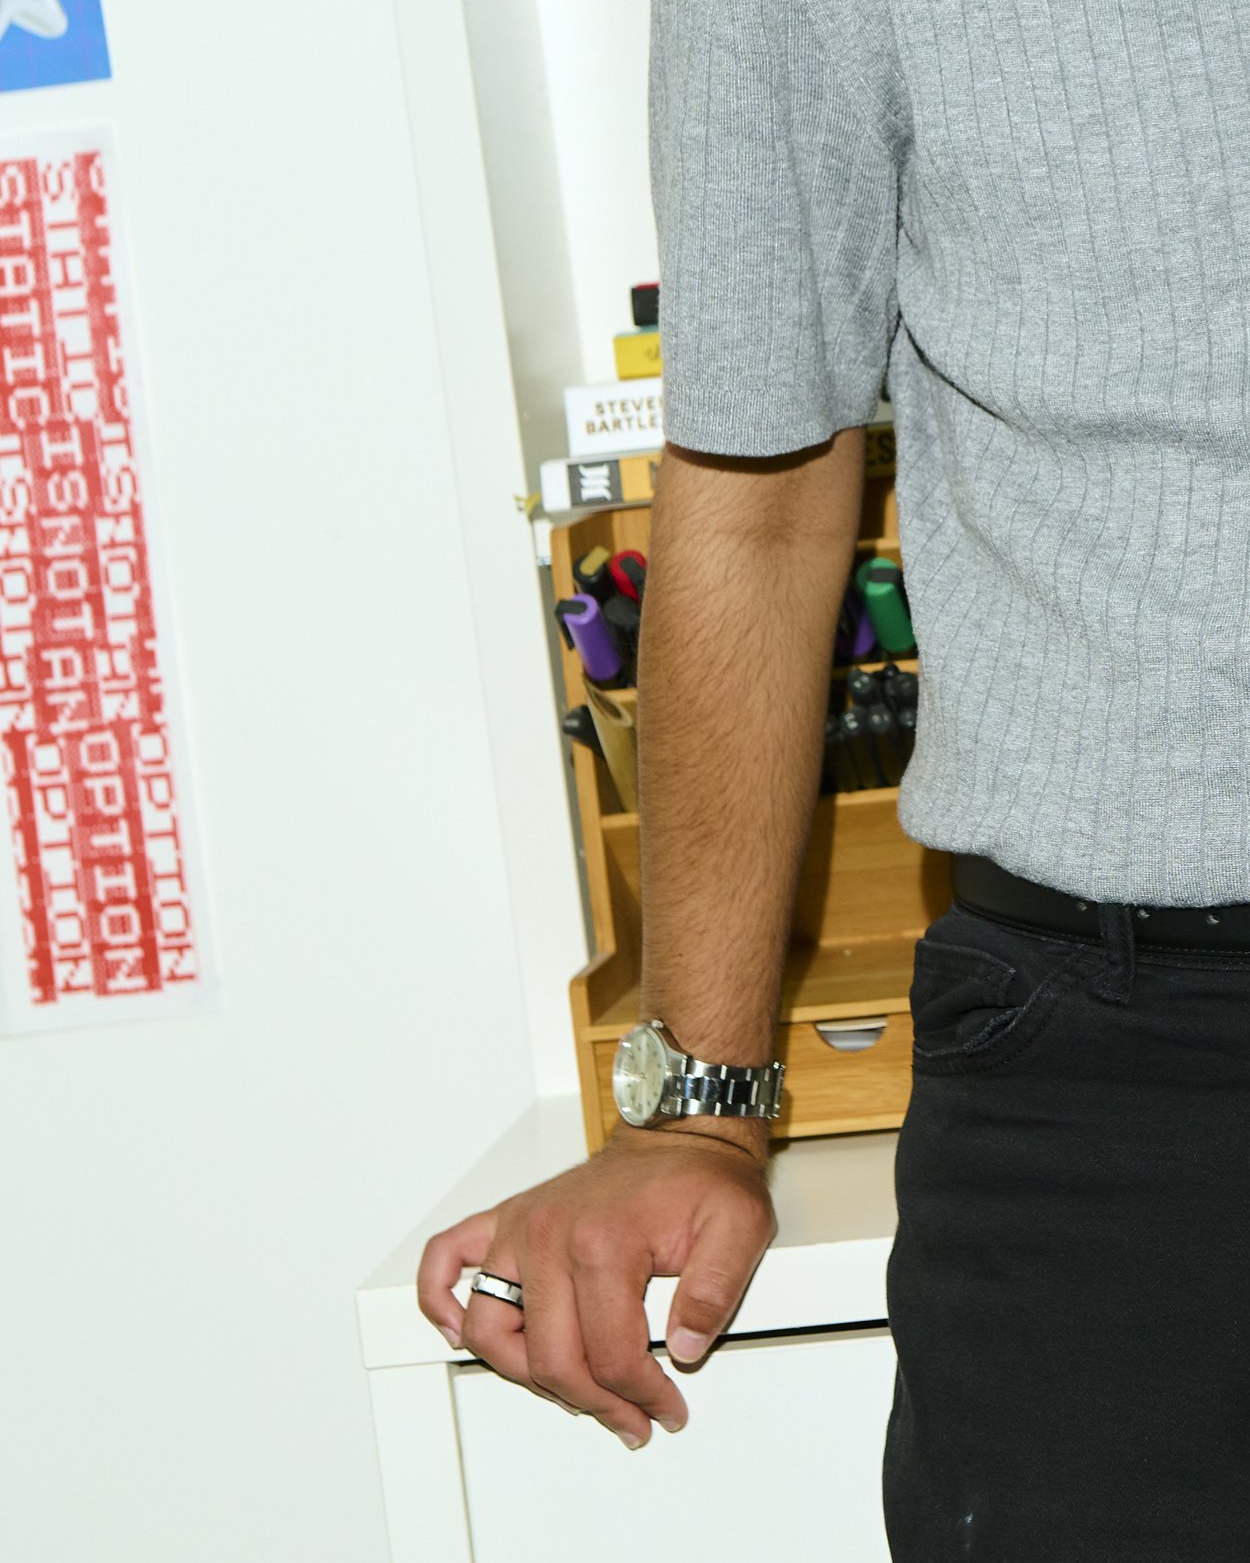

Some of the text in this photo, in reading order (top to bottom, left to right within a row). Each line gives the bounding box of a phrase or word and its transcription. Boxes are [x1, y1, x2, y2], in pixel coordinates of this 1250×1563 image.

[100, 421, 138, 513] IS
[594, 395, 663, 415] STEVE
[0, 165, 50, 431] STATIC
[26, 735, 93, 994] OPTION
[42, 160, 148, 992] STATIC IS NOT AN OPTION
[98, 513, 140, 641] NOT
[136, 725, 199, 983] OPTION
